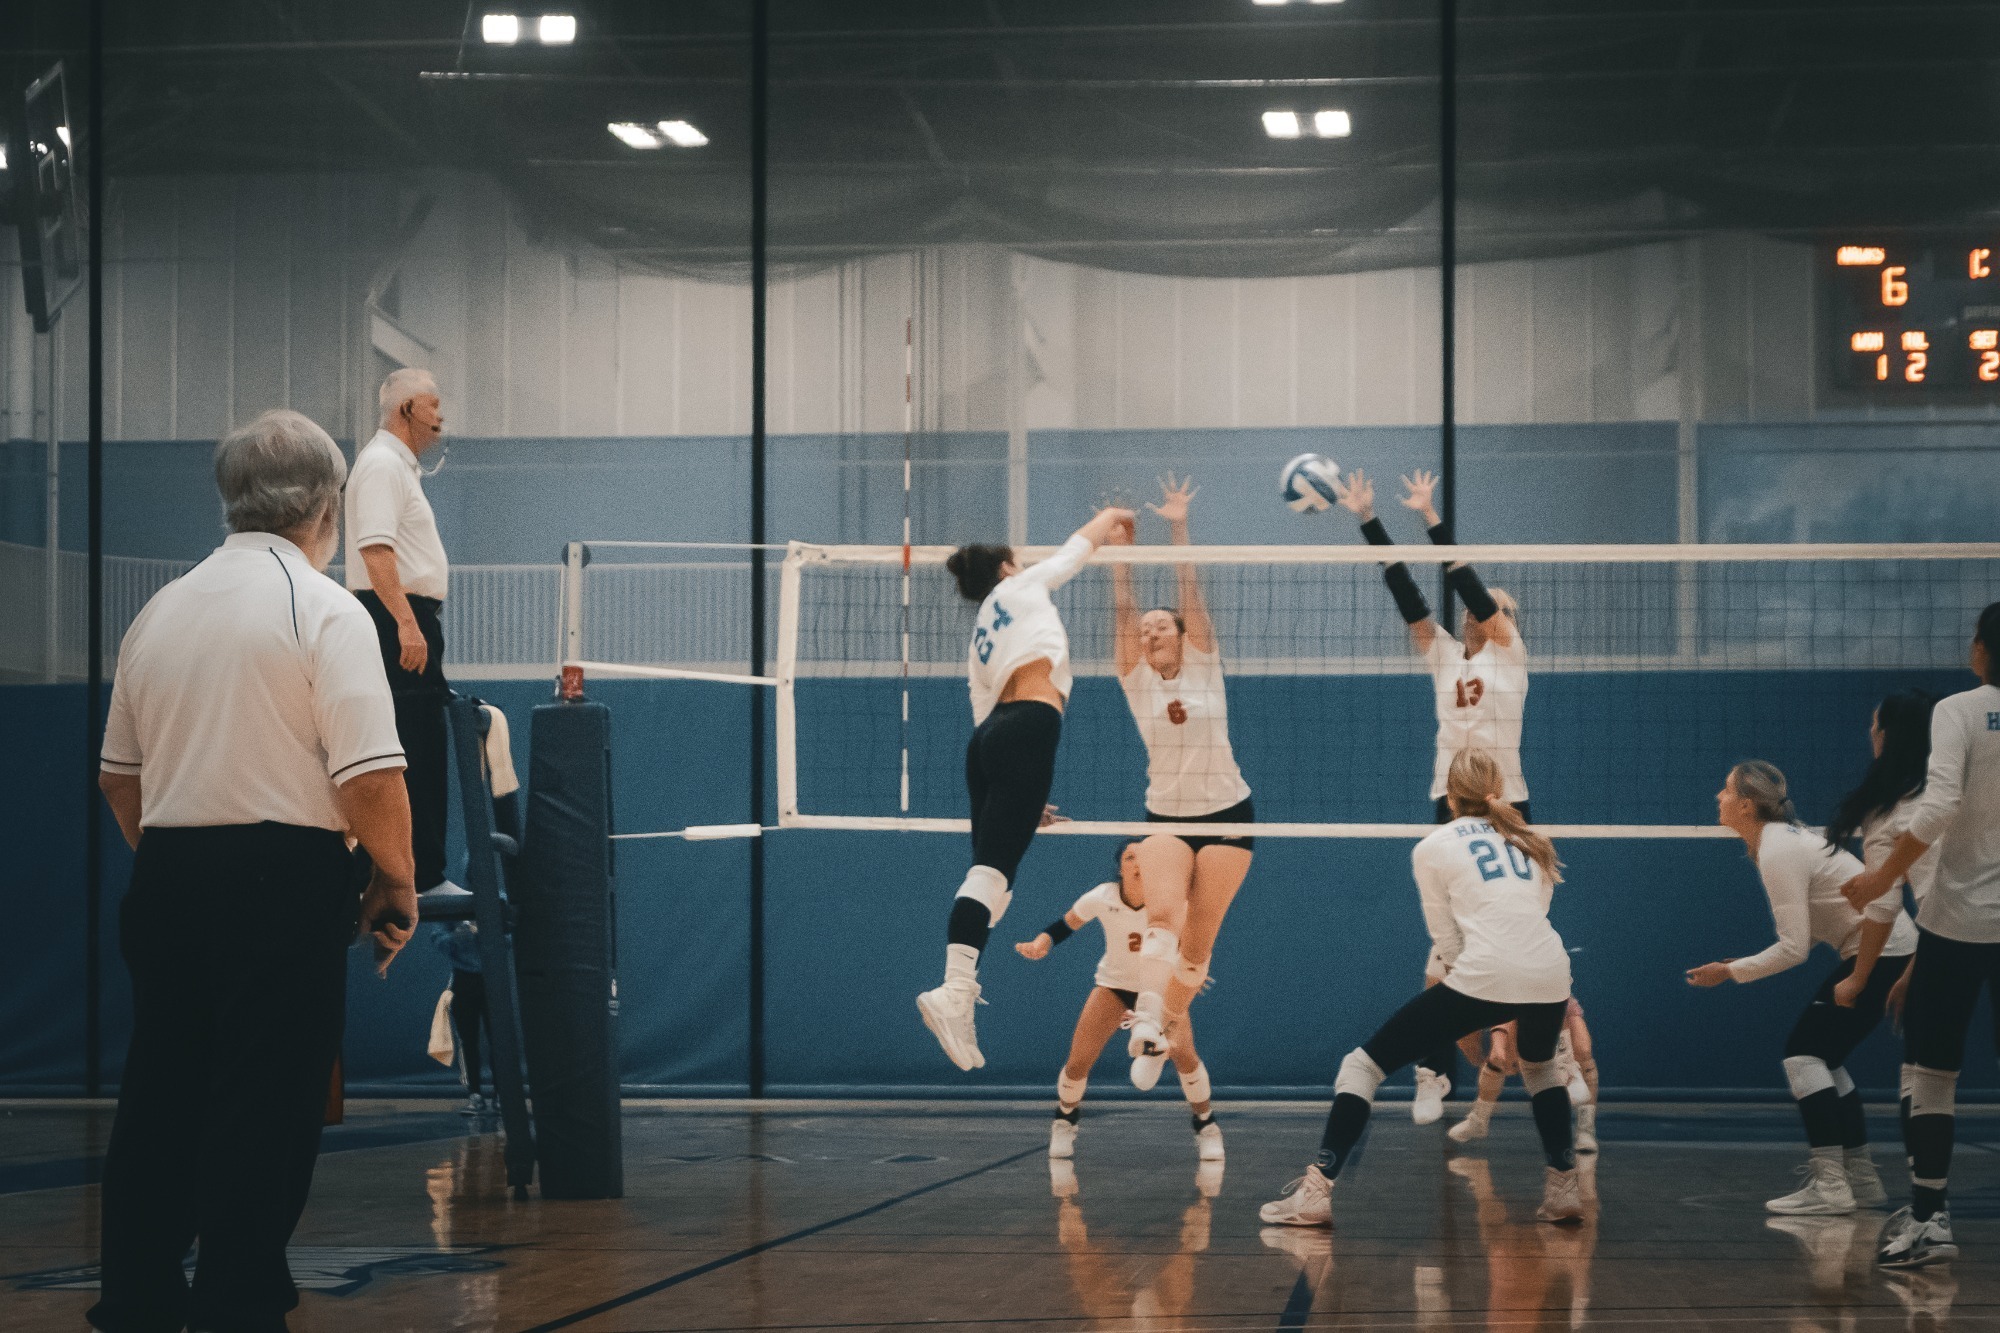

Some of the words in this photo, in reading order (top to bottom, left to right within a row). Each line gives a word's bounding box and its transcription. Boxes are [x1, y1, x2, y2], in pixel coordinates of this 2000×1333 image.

[1881, 266, 1908, 306] 6
[1876, 353, 1888, 381] 1
[1905, 352, 1927, 382] 2
[1978, 351, 2000, 381] 2
[974, 599, 1013, 665] 24
[1456, 678, 1484, 707] 13
[1468, 839, 1533, 881] 20
